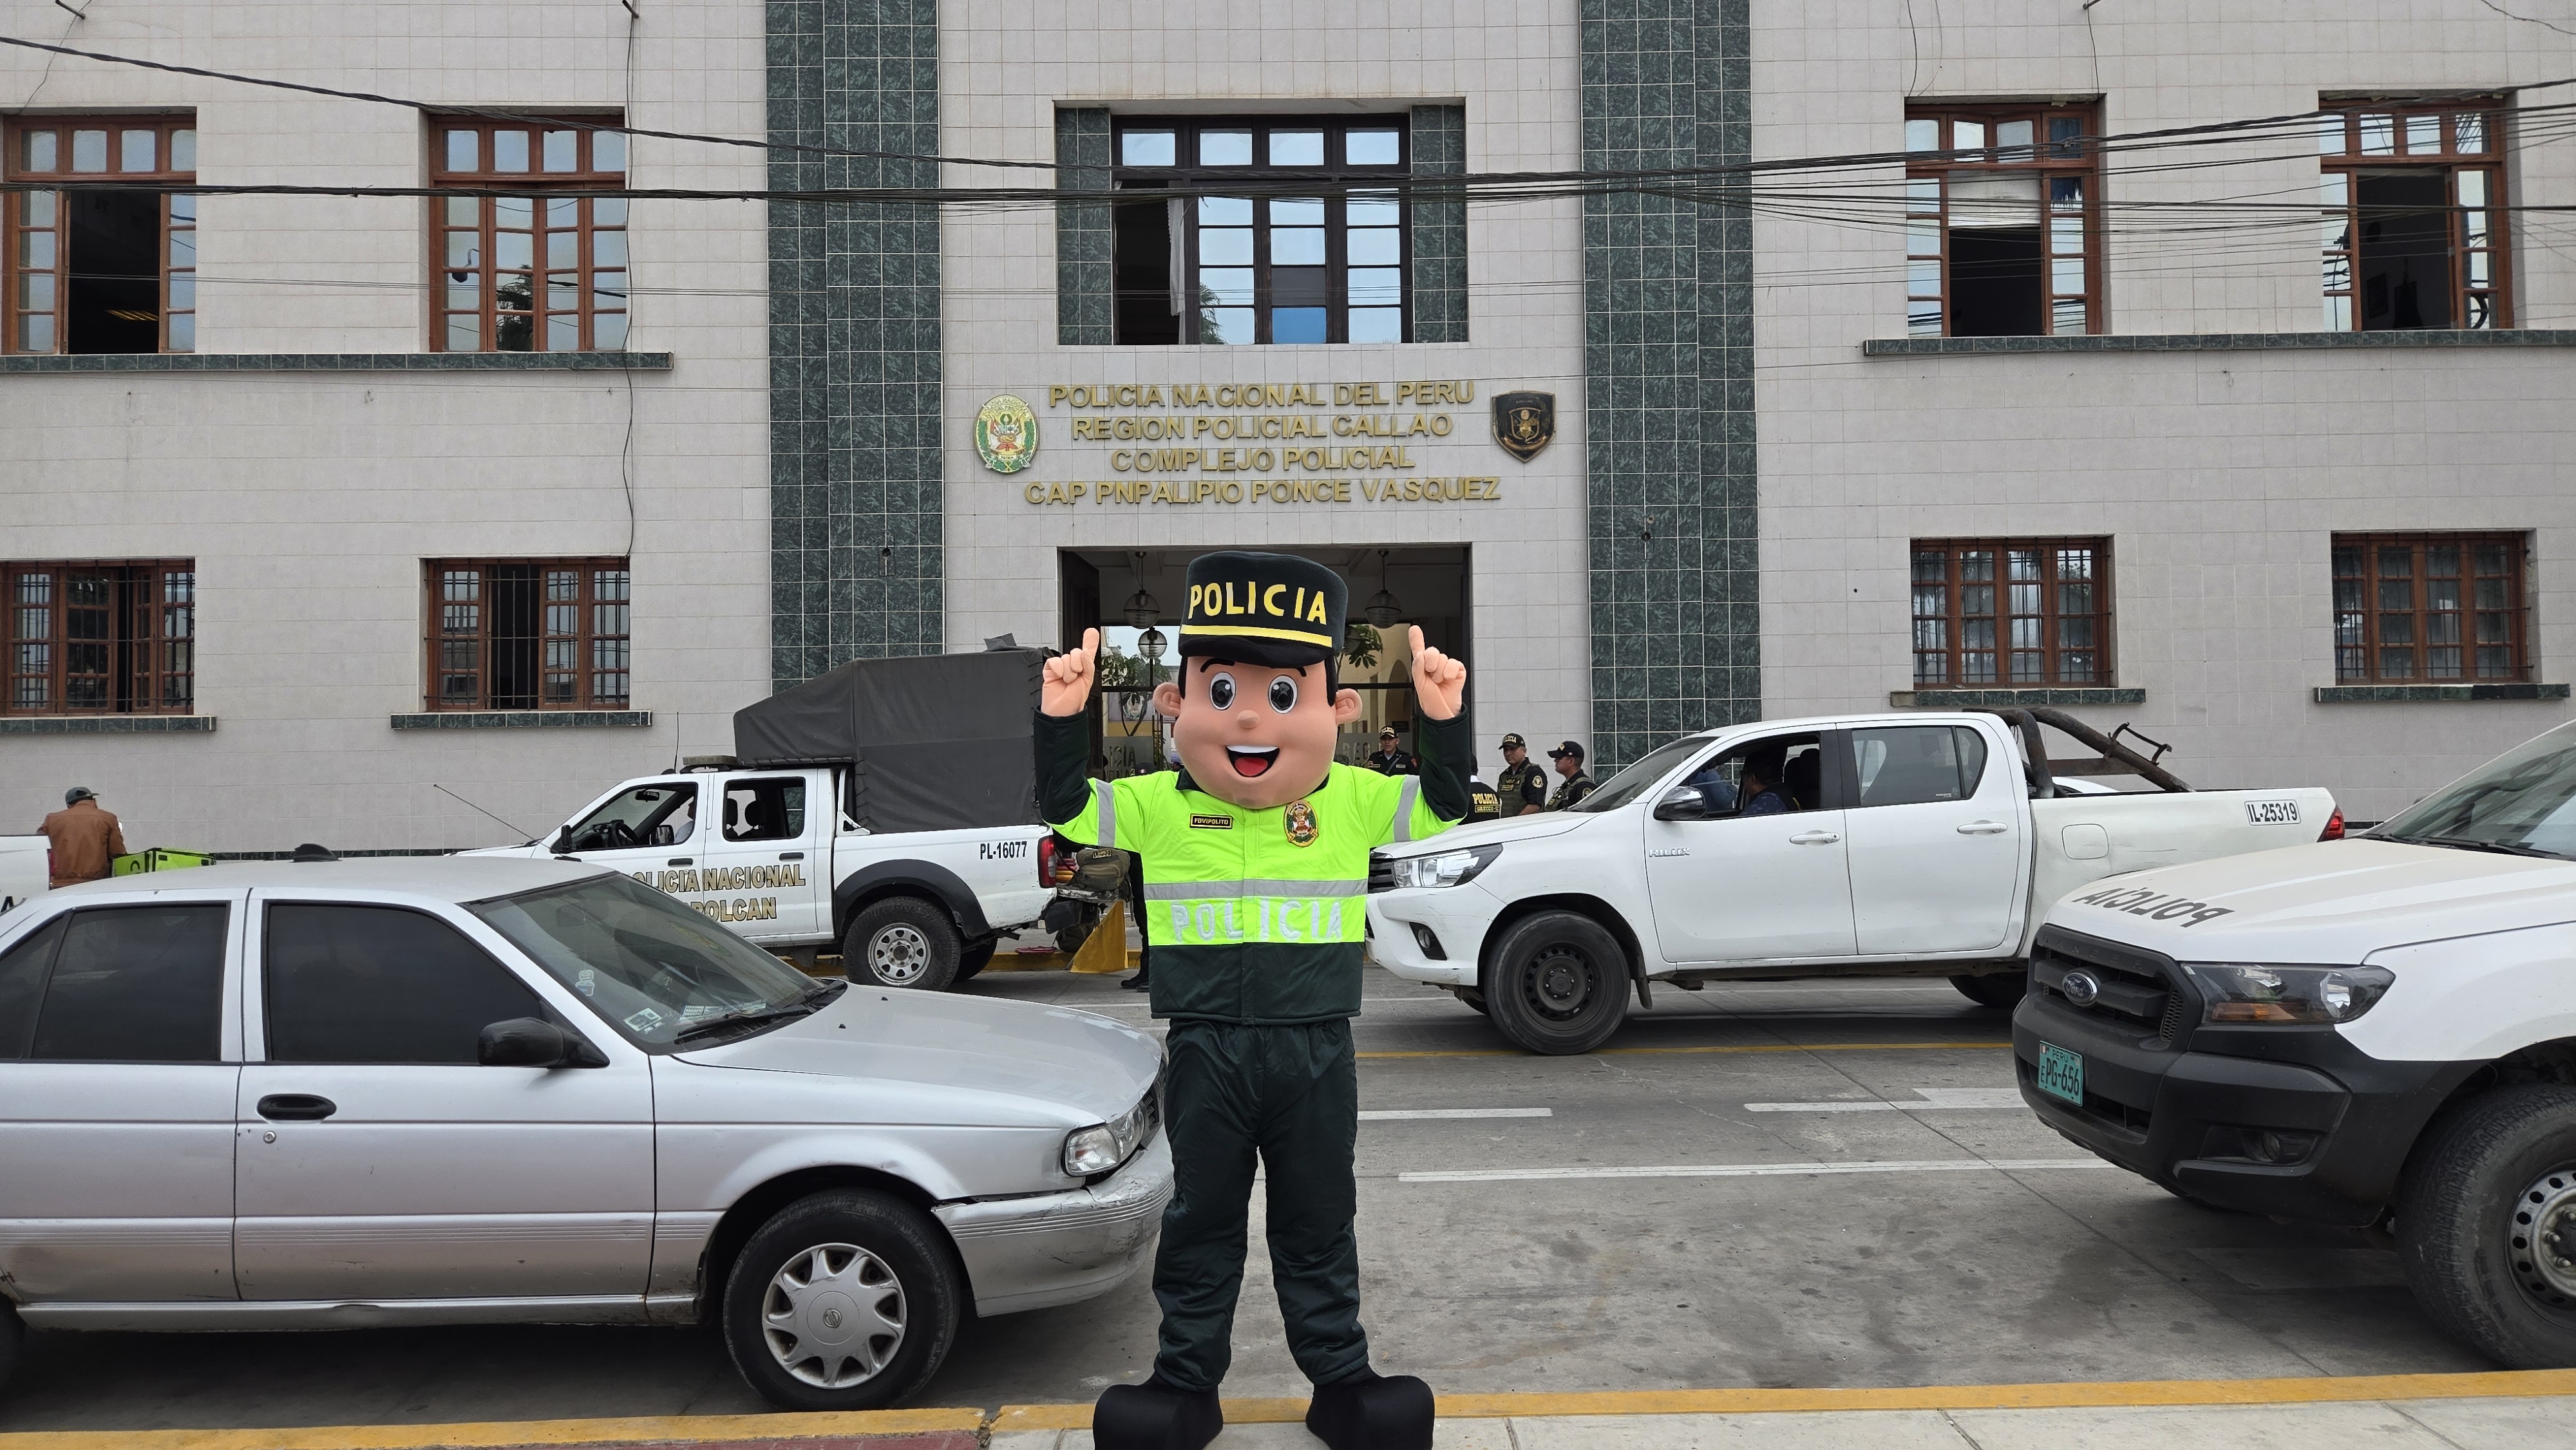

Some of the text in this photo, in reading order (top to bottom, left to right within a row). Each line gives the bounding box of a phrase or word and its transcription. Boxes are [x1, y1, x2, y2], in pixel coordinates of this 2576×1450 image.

[1050, 381, 1474, 407] POLICIA NACIONAL DEL PERU
[1073, 413, 1453, 440] REGION POLICIAL CALLAO
[1112, 445, 1415, 471] COMPLEJO POLICIAL
[1025, 482, 1087, 504] CAP
[1251, 480, 1351, 502] PONCE
[1361, 476, 1501, 502] VASQUEZ
[1188, 581, 1327, 625] POLICIA
[1472, 793, 1499, 804] POLICIA
[2247, 802, 2298, 822] IL-25319
[980, 841, 1027, 860] PL-16077
[1649, 847, 1690, 857] HILUX
[703, 864, 806, 891] NACIONAL
[1171, 897, 1342, 942] POLICIA
[2052, 1049, 2069, 1063] PERU
